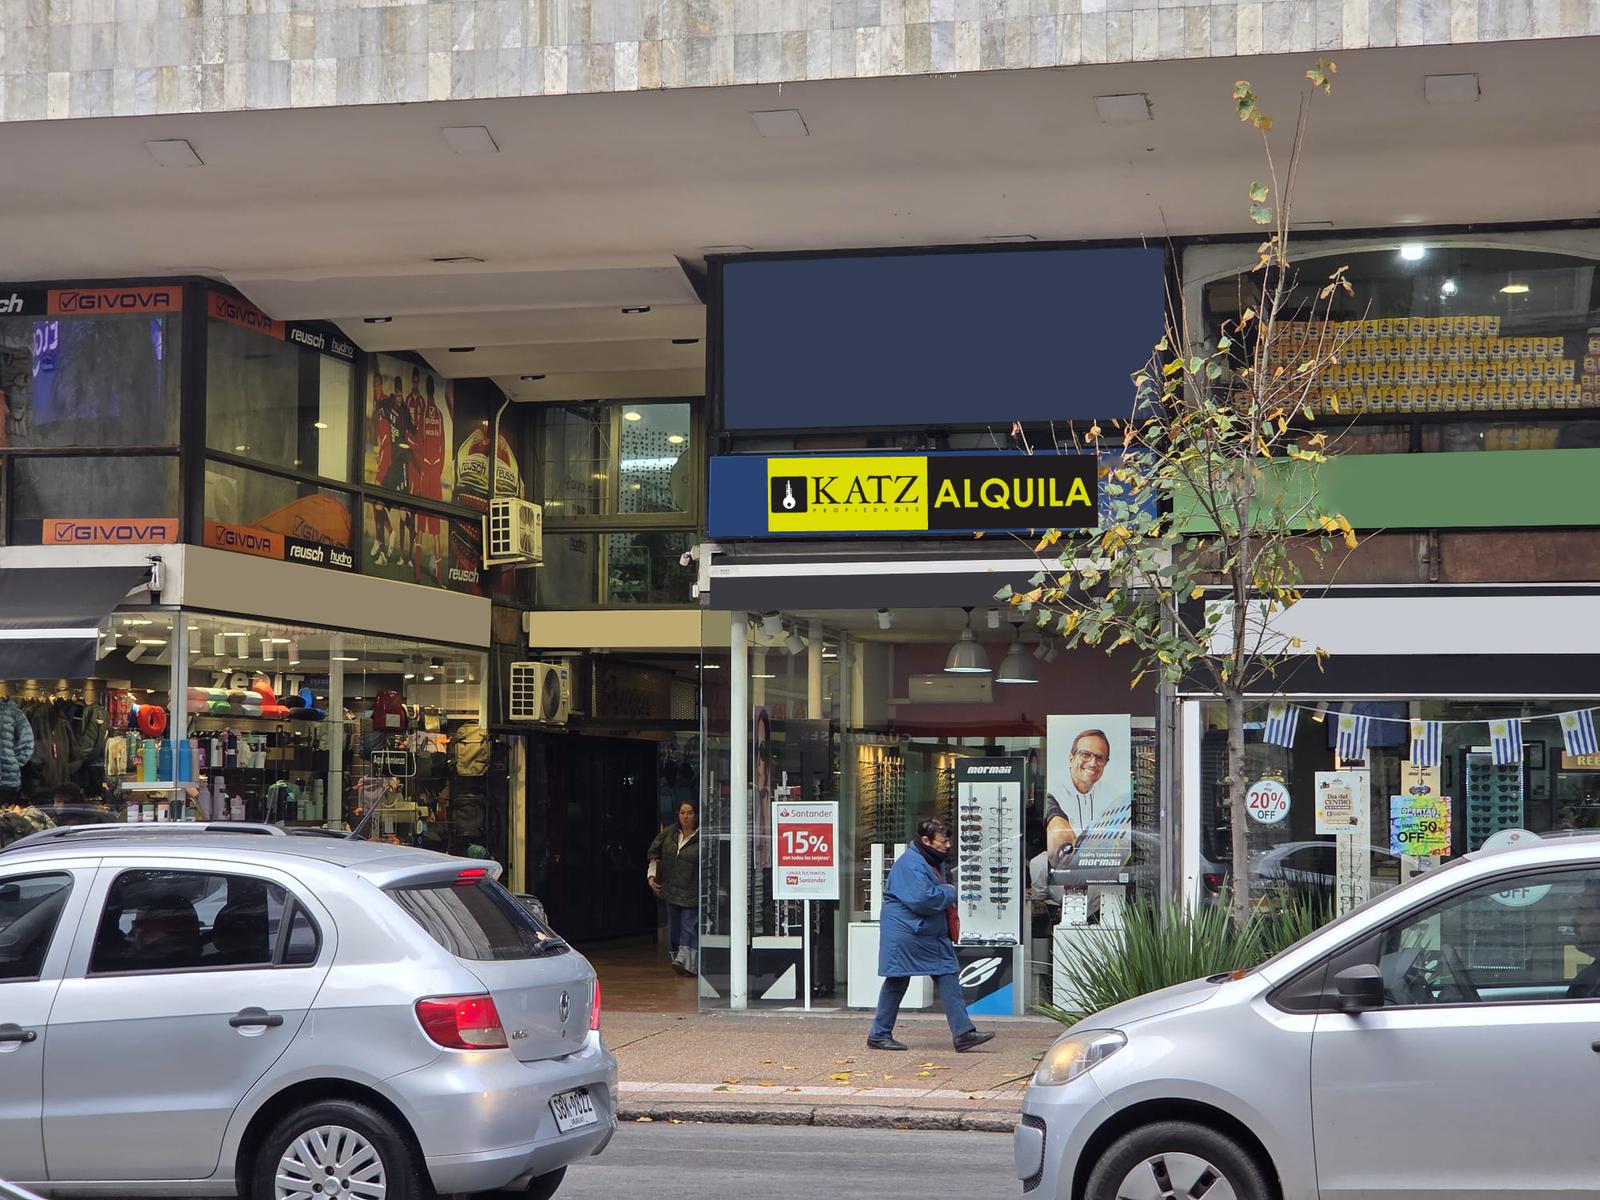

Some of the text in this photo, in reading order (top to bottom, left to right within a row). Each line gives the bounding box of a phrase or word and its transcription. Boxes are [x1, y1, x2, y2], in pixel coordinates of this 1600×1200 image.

[76, 293, 170, 310] GIVOVA
[226, 303, 273, 333] GIVOVA
[291, 327, 354, 357] reusch hydro
[811, 475, 919, 504] KATZ
[934, 477, 1092, 510] ALQUILA
[74, 524, 166, 541] GIVOVA
[225, 528, 272, 552] GIVOVA
[290, 544, 353, 568] reusch hydro
[448, 567, 480, 583] reusch
[967, 765, 1012, 774] mormaii
[1250, 791, 1286, 810] 20%
[791, 809, 832, 818] Santander
[1257, 810, 1276, 819] OFF
[782, 830, 828, 854] 15%
[1397, 831, 1425, 843] OFF
[1078, 858, 1121, 866] mormaii
